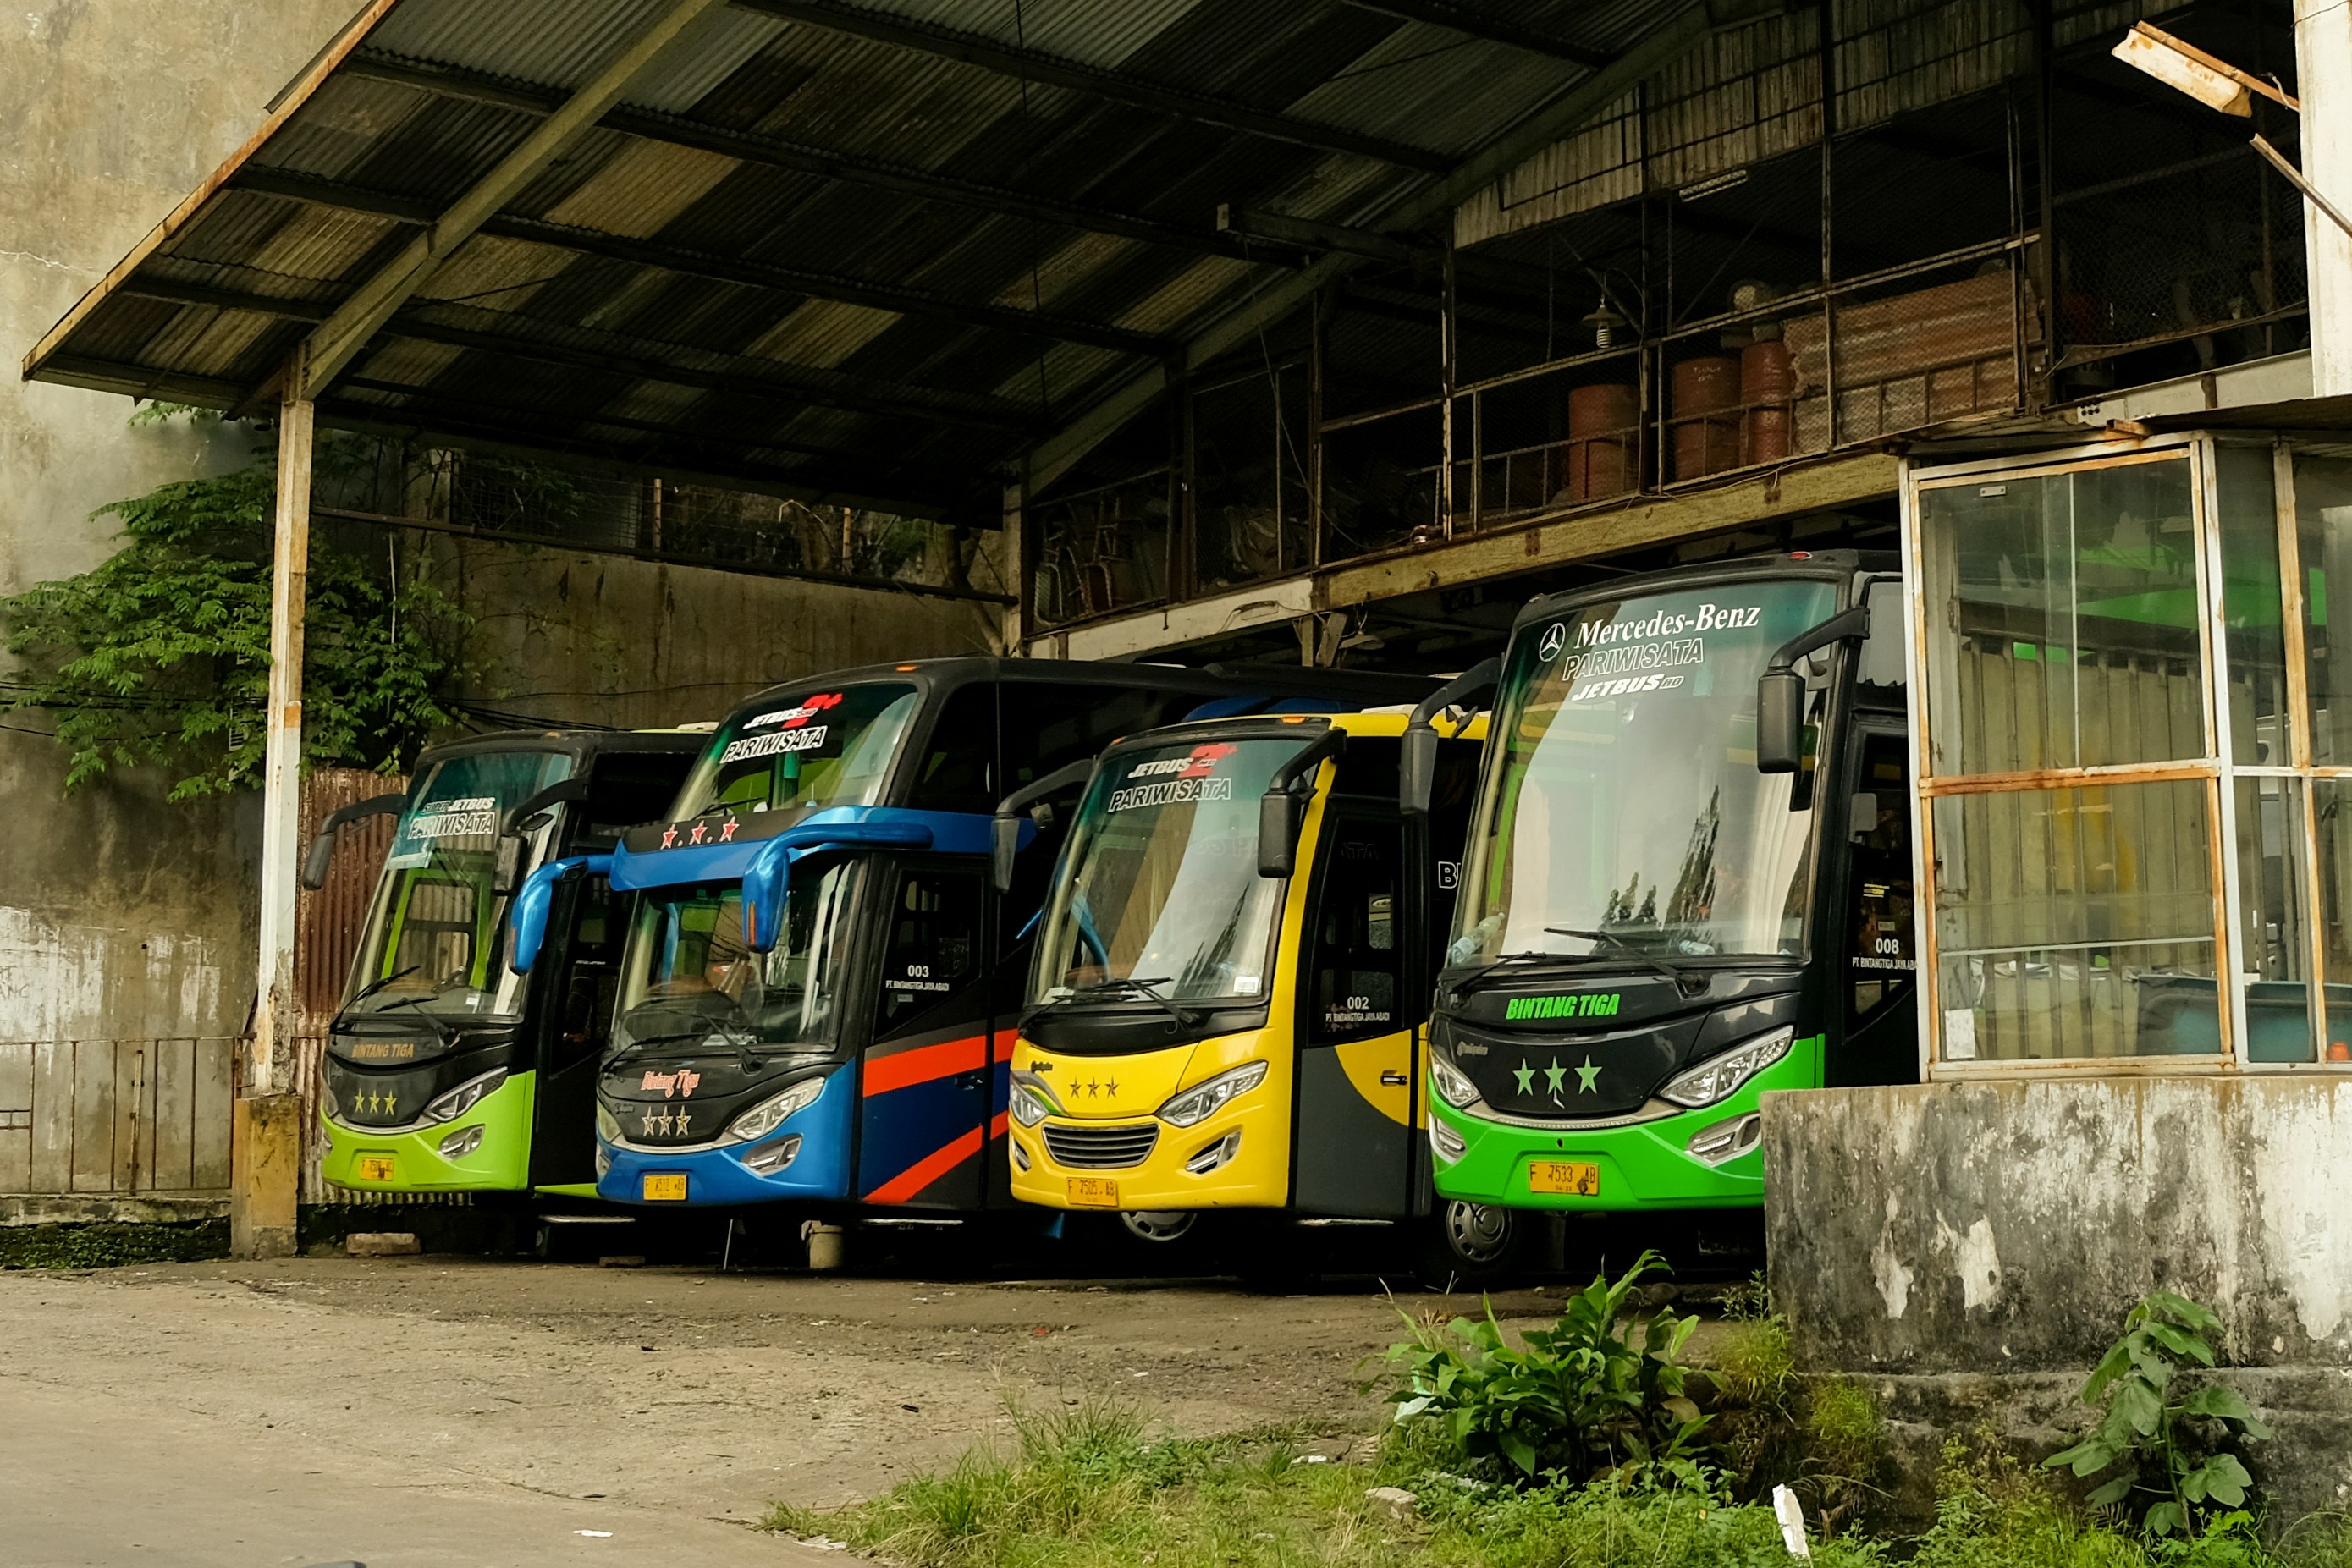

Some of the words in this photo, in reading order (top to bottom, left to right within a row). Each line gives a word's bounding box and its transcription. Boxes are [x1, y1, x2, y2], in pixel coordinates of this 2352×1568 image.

[1573, 603, 1761, 649] Mercedes-Benz
[1562, 638, 1705, 680] PARIWISATA
[1572, 674, 1665, 701] JETBUS
[1660, 675, 1684, 689] HD
[719, 725, 828, 764] PARIWISATA
[1127, 757, 1194, 778] JETBUS
[448, 797, 495, 811] JETBUS
[1107, 778, 1231, 812] PARIWISATA
[407, 812, 495, 840] PARIWISATA
[1875, 938, 1899, 955] 008
[907, 965, 929, 977] 003
[1347, 996, 1369, 1010] 002
[1506, 996, 1578, 1019] BINTANG
[1578, 993, 1620, 1016] TIGA
[352, 1043, 389, 1058] BINTANG
[391, 1043, 414, 1058] TIGA
[1529, 1164, 1536, 1181] F
[1550, 1164, 1573, 1183] 7533
[1068, 1179, 1073, 1194] F
